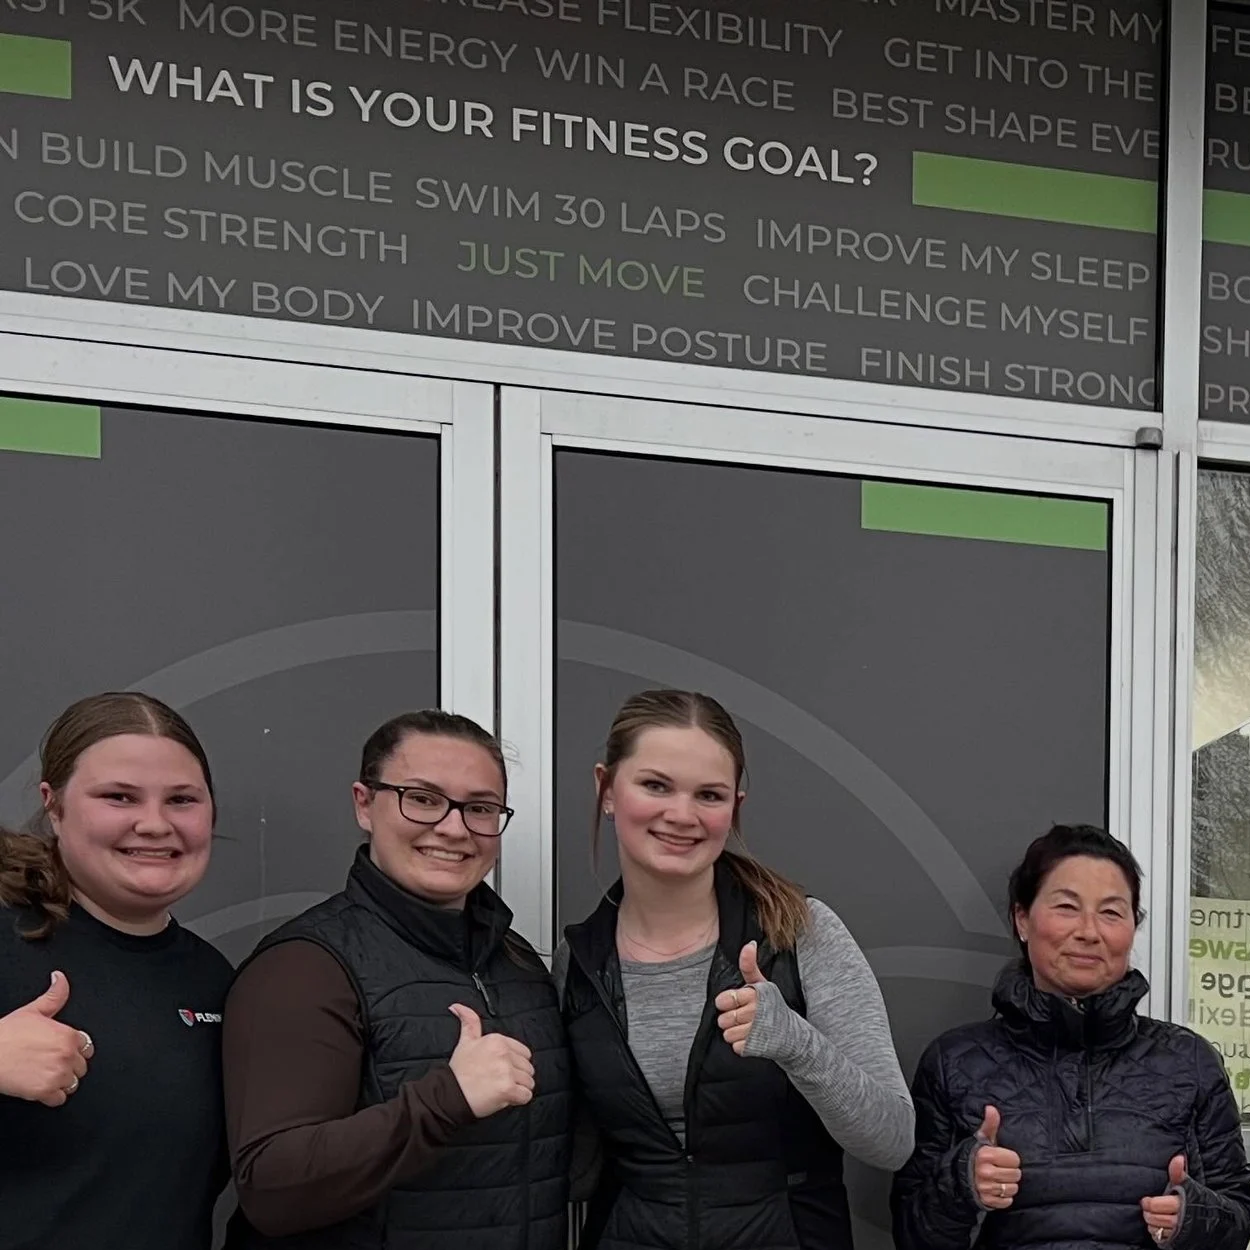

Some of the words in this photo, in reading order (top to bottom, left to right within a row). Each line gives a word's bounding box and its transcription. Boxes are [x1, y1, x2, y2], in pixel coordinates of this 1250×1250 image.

[178, 0, 316, 47] MORE
[335, 20, 517, 72] ENERGY
[536, 48, 624, 88] WIN
[640, 64, 669, 94] A
[685, 68, 794, 111] RACE
[833, 89, 933, 128] BEST
[945, 104, 1076, 148] SHAPE
[599, 0, 842, 57] FLEXIBILITY
[885, 38, 962, 73] GET
[976, 50, 1067, 88] INTO
[1080, 64, 1153, 101] THE
[1110, 9, 1162, 43] MY
[108, 55, 274, 108] WHAT
[291, 79, 334, 117] IS
[349, 86, 494, 138] YOUR
[512, 107, 708, 165] FITNESS
[723, 136, 878, 186] GOAL?
[15, 192, 148, 234] CORE
[164, 208, 406, 264] STRENGTH
[458, 241, 564, 281] JUST
[580, 255, 704, 297] MOVE
[744, 276, 986, 328] CHALLENGE
[1001, 303, 1148, 344] MYSELF
[43, 132, 187, 177] BUILD
[206, 152, 392, 203] MUSCLE
[416, 178, 539, 221] SWIM
[555, 195, 605, 227] 30
[622, 203, 725, 242] LAPS
[758, 219, 946, 268] IMPROVE
[962, 243, 1019, 276] MY
[1032, 252, 1149, 290] SLEEP
[25, 257, 149, 300] LOVE
[168, 272, 236, 308] MY
[252, 281, 383, 325] BODY
[413, 300, 615, 350] IMPROVE
[632, 322, 827, 373] POSTURE
[861, 348, 989, 389] FINISH
